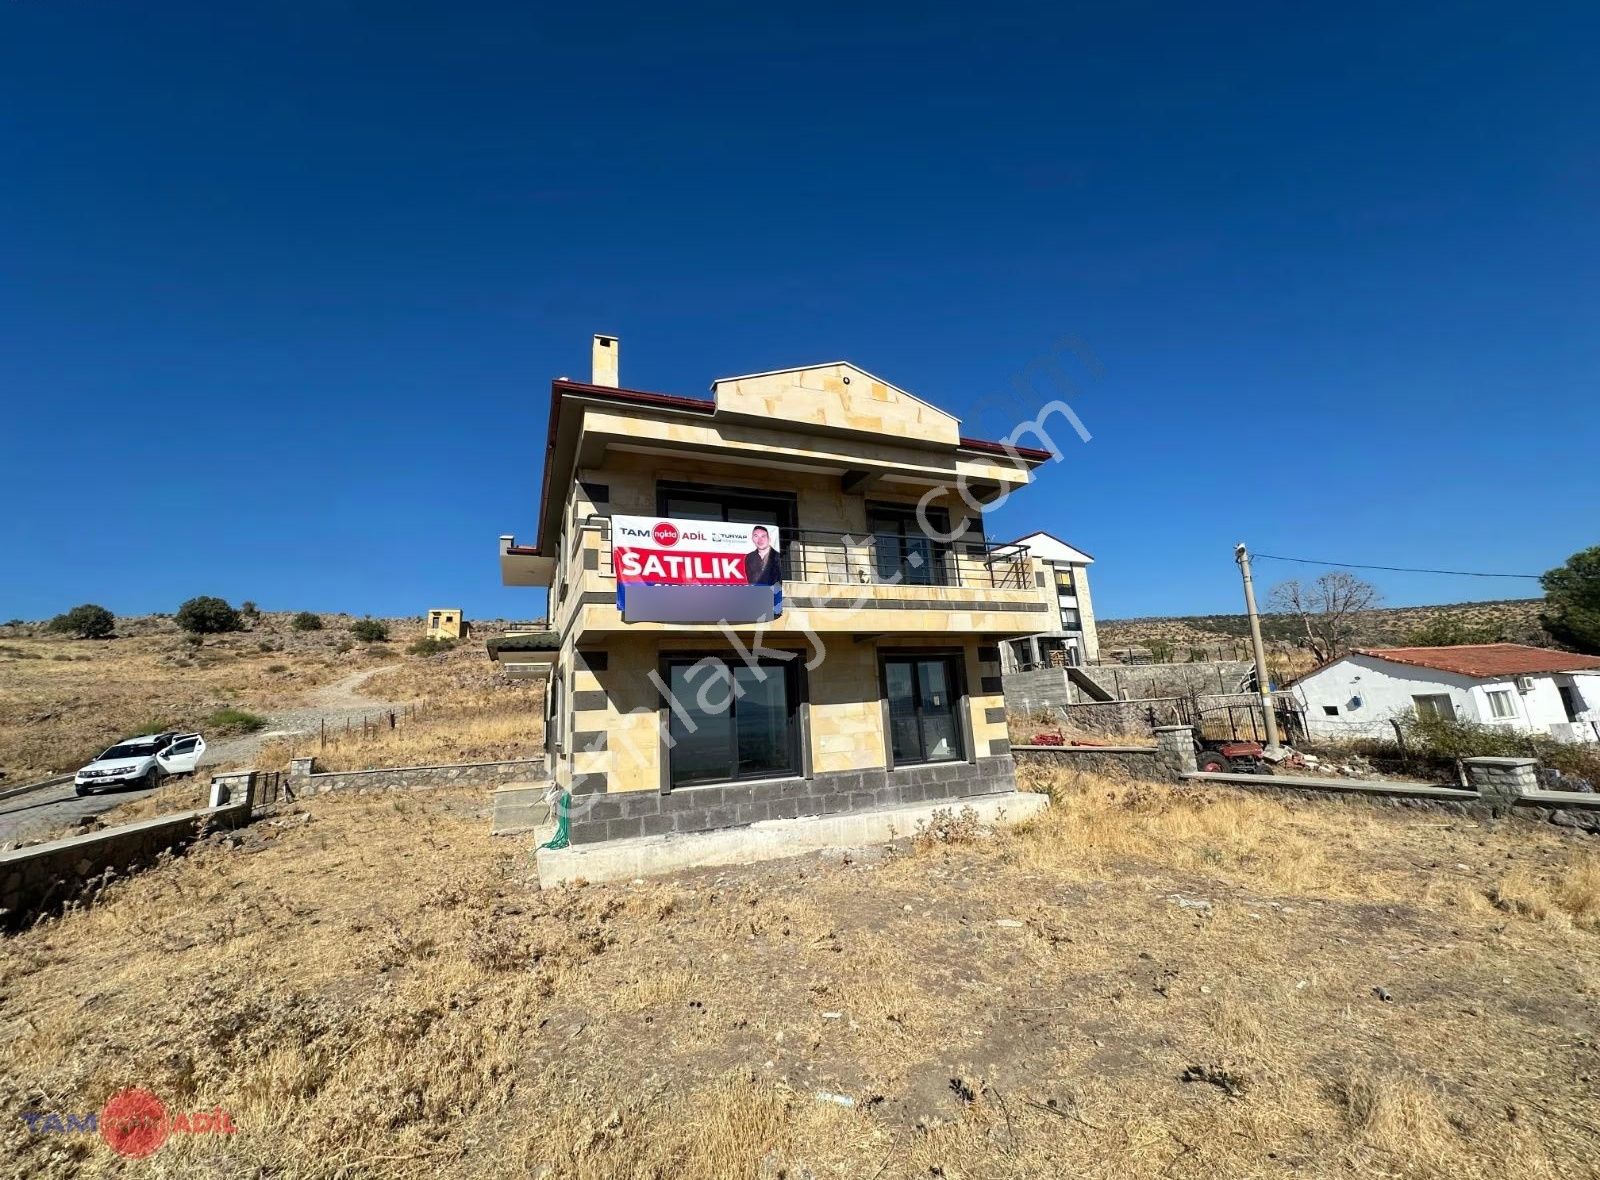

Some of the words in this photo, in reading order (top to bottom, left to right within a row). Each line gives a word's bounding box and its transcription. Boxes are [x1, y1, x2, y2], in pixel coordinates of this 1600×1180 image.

[620, 528, 650, 538] TAM
[682, 530, 707, 541] ADİL
[622, 552, 744, 579] SATILIK
